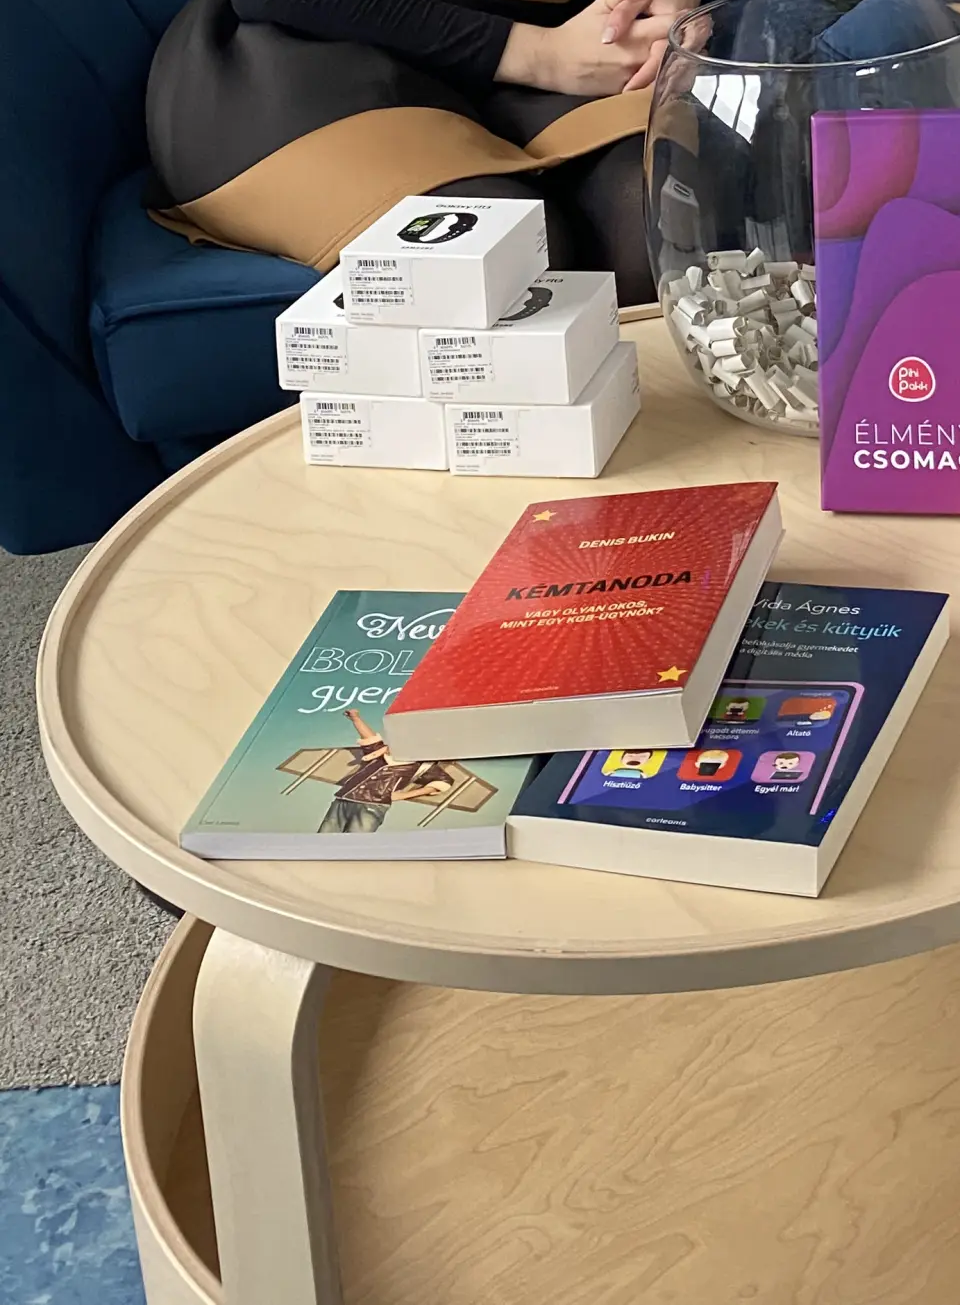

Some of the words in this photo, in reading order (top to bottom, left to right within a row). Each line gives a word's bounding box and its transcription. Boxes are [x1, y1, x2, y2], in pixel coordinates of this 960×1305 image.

[578, 536, 627, 549] DENIS
[627, 531, 675, 544] BUKIN
[505, 571, 692, 601] KÉMTANODA
[524, 607, 563, 619] VAGY
[562, 603, 607, 616] OLYAN
[795, 599, 861, 616] Ágnes
[500, 619, 537, 629] MINT
[536, 617, 564, 627] EGY
[794, 618, 819, 634] és
[822, 622, 902, 641] kütyük
[784, 650, 813, 659] média
[797, 643, 859, 654] gyermekedet
[680, 782, 722, 792] Babysitter
[754, 785, 779, 794] Egyél
[779, 785, 800, 793] már!
